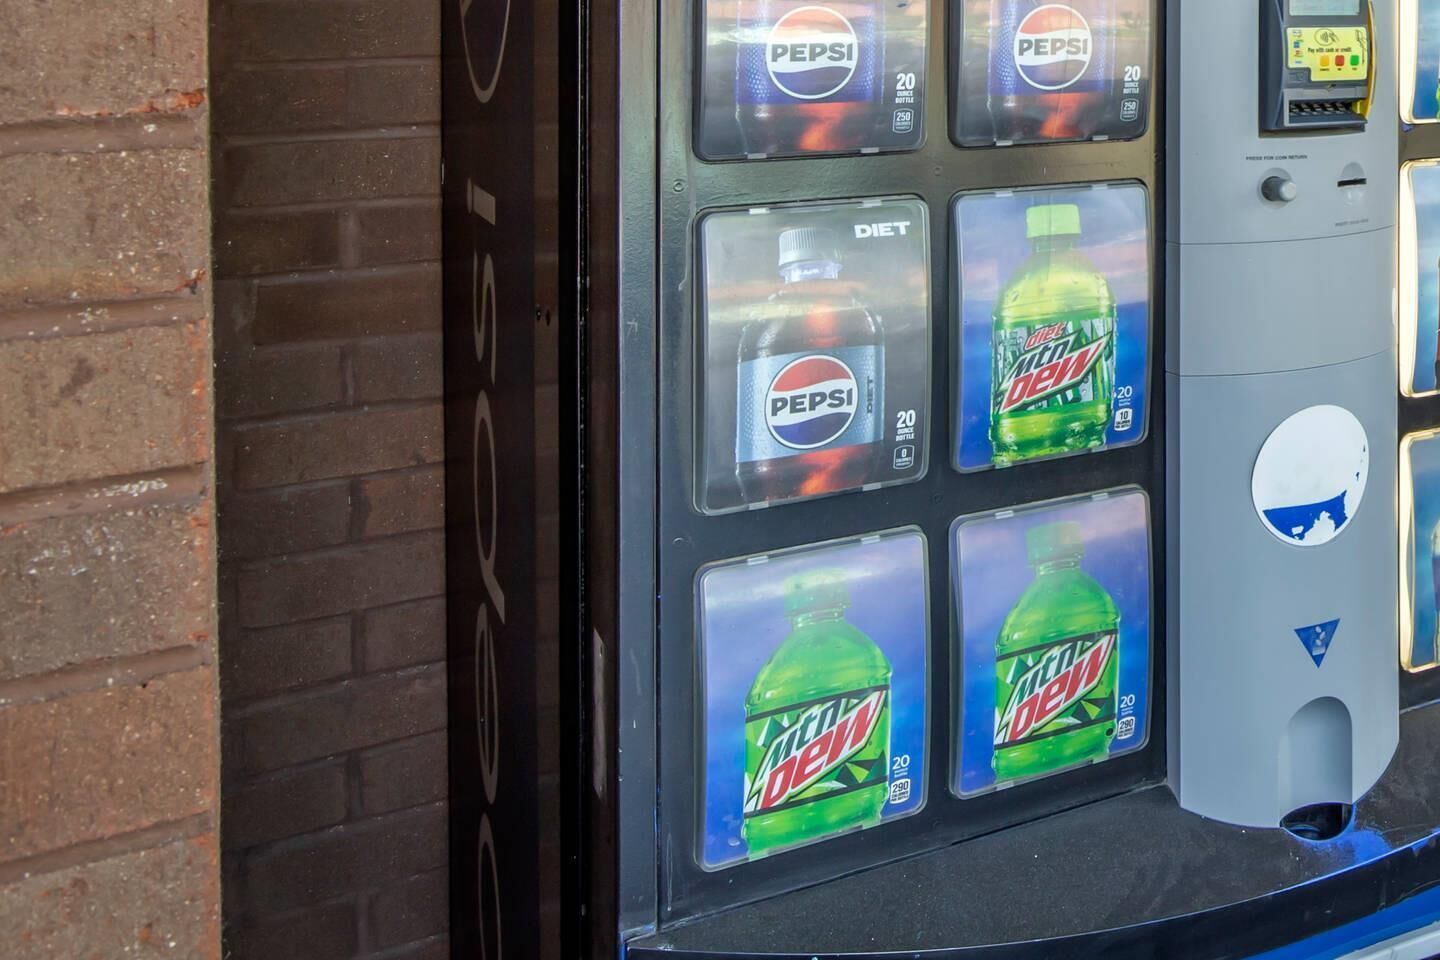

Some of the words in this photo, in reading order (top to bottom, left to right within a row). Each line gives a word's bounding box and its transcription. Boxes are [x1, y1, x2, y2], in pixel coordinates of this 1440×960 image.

[771, 42, 853, 63] PEPSI
[1018, 38, 1088, 57] PEPSI
[1124, 65, 1141, 81] 20
[896, 73, 916, 90] 20
[1123, 101, 1137, 111] 250
[896, 112, 911, 121] 250
[854, 221, 911, 238] DIET
[1026, 322, 1065, 349] diet
[866, 375, 874, 414] DIET
[1117, 386, 1133, 399] 20
[771, 388, 853, 417] PEPSI
[896, 409, 916, 428] 20
[1119, 410, 1129, 420] 10
[895, 433, 915, 441] BOTTLE
[901, 449, 907, 458] 0
[1120, 694, 1136, 708] 20
[1119, 718, 1134, 730] 290
[892, 754, 910, 770] 20
[892, 780, 909, 793] 290
